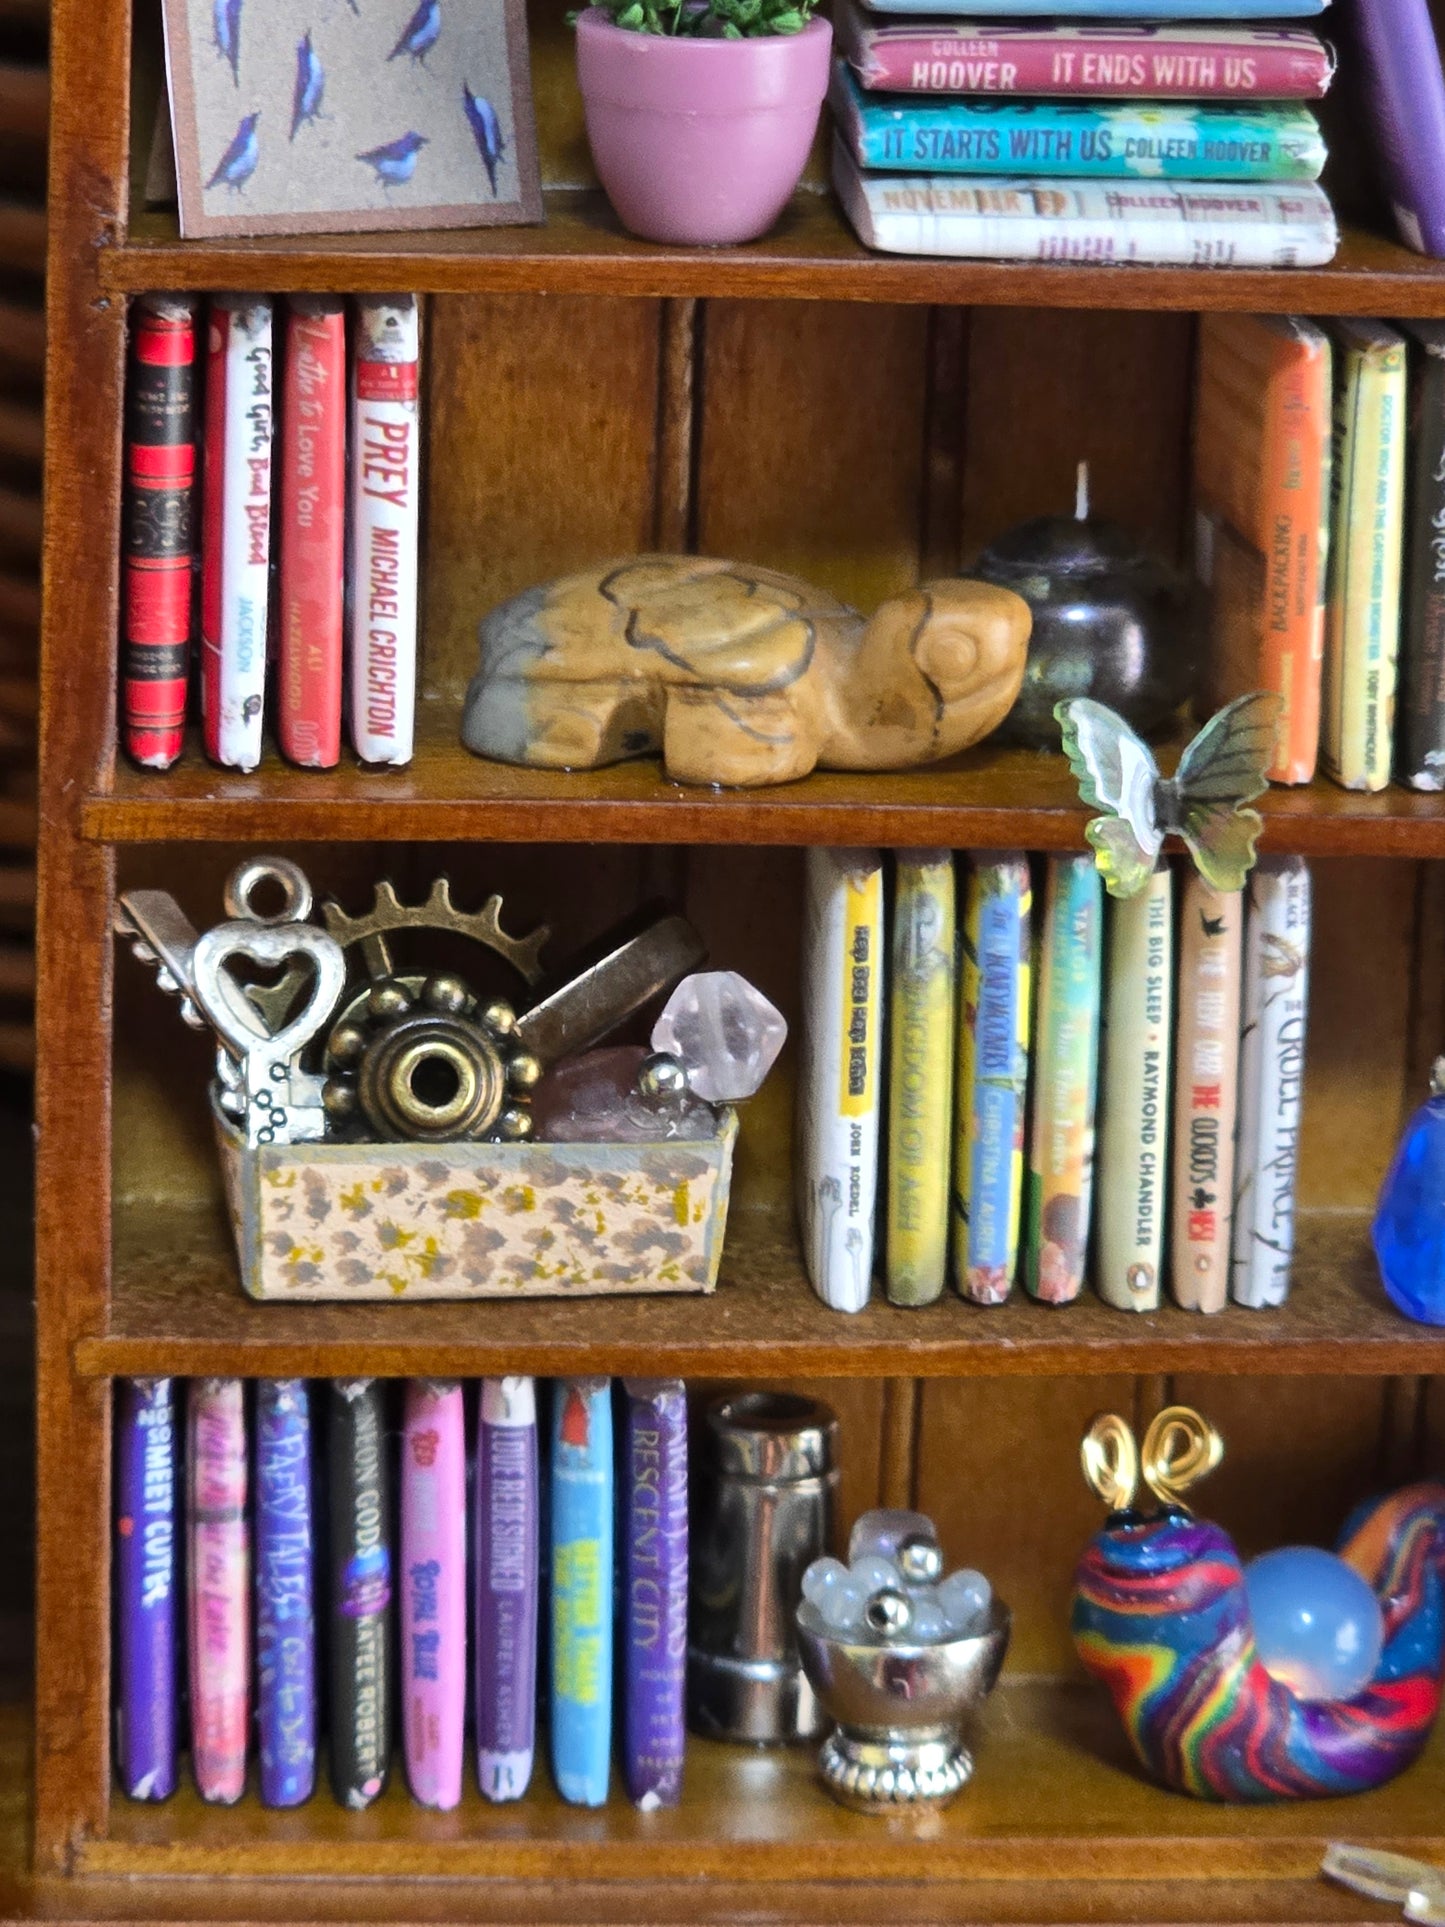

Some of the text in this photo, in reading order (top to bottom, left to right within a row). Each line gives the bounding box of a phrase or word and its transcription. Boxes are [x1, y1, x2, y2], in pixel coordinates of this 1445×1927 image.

[911, 60, 1017, 91] HOOVER
[1052, 53, 1257, 89] IT ENDS WITH US
[883, 127, 1113, 161] IT STARTS WITH US
[1125, 137, 1271, 163] COLLEEN HOOVER
[246, 347, 271, 396] Good
[247, 458, 268, 496] Bad
[297, 425, 320, 478] Love
[360, 416, 410, 509] PREY
[244, 505, 268, 565] Blood
[297, 485, 320, 528] You
[238, 598, 254, 673] JACKSON
[367, 526, 400, 738] MICHAEL CRICHTON
[1145, 896, 1167, 1025] THE BIG SLEEP
[1134, 1050, 1160, 1247] RAYMOND CHANDLER
[1262, 1017, 1305, 1230] CRUEL PRINCE
[849, 1122, 862, 1218] JOHN ROEDEL
[143, 1443, 173, 1513] MEET
[354, 1411, 381, 1559] NEON GODS
[490, 1430, 526, 1592] LOVE REDESIGNED
[631, 1428, 661, 1569] RESCENT
[260, 1433, 310, 1604] FAERY TALES
[631, 1577, 662, 1651] CITY
[356, 1684, 377, 1773] ROBERT
